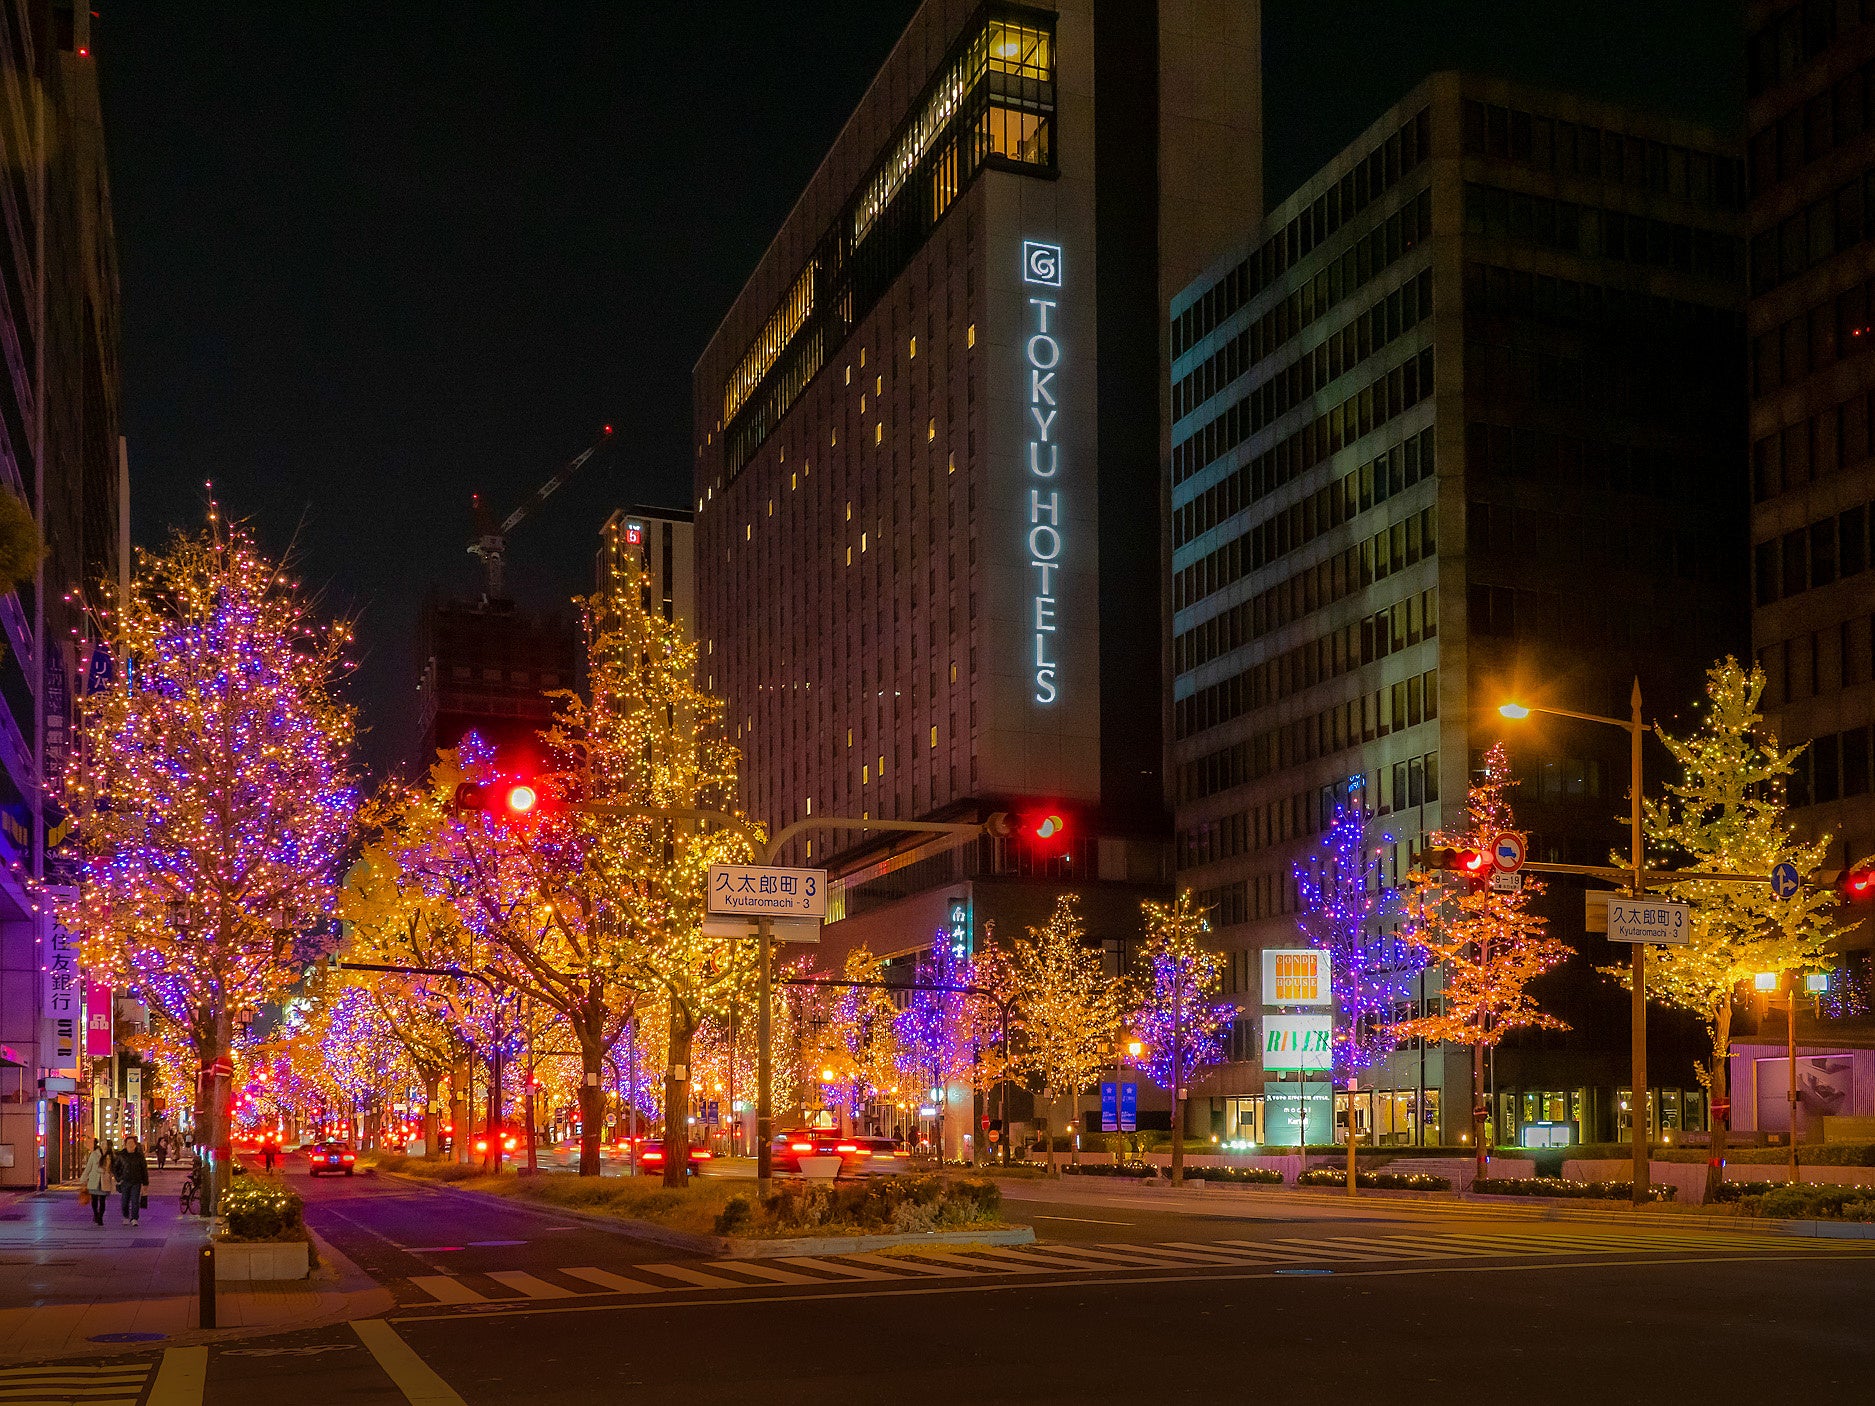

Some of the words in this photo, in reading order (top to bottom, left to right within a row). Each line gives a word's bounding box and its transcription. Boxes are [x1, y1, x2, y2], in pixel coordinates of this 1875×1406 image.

[1027, 298, 1059, 477] TOKYU
[1029, 490, 1061, 703] HOTELS
[716, 873, 798, 895] 久太郎町
[805, 877, 816, 896] 3
[725, 895, 793, 907] Kyutaromachi
[803, 899, 810, 908] 3
[1613, 907, 1670, 926] 久太郎町
[1675, 911, 1682, 927] 3
[1620, 926, 1666, 938] Kyutaromachi
[1277, 978, 1317, 986] HOUSE
[1266, 1030, 1330, 1052] RIVER
